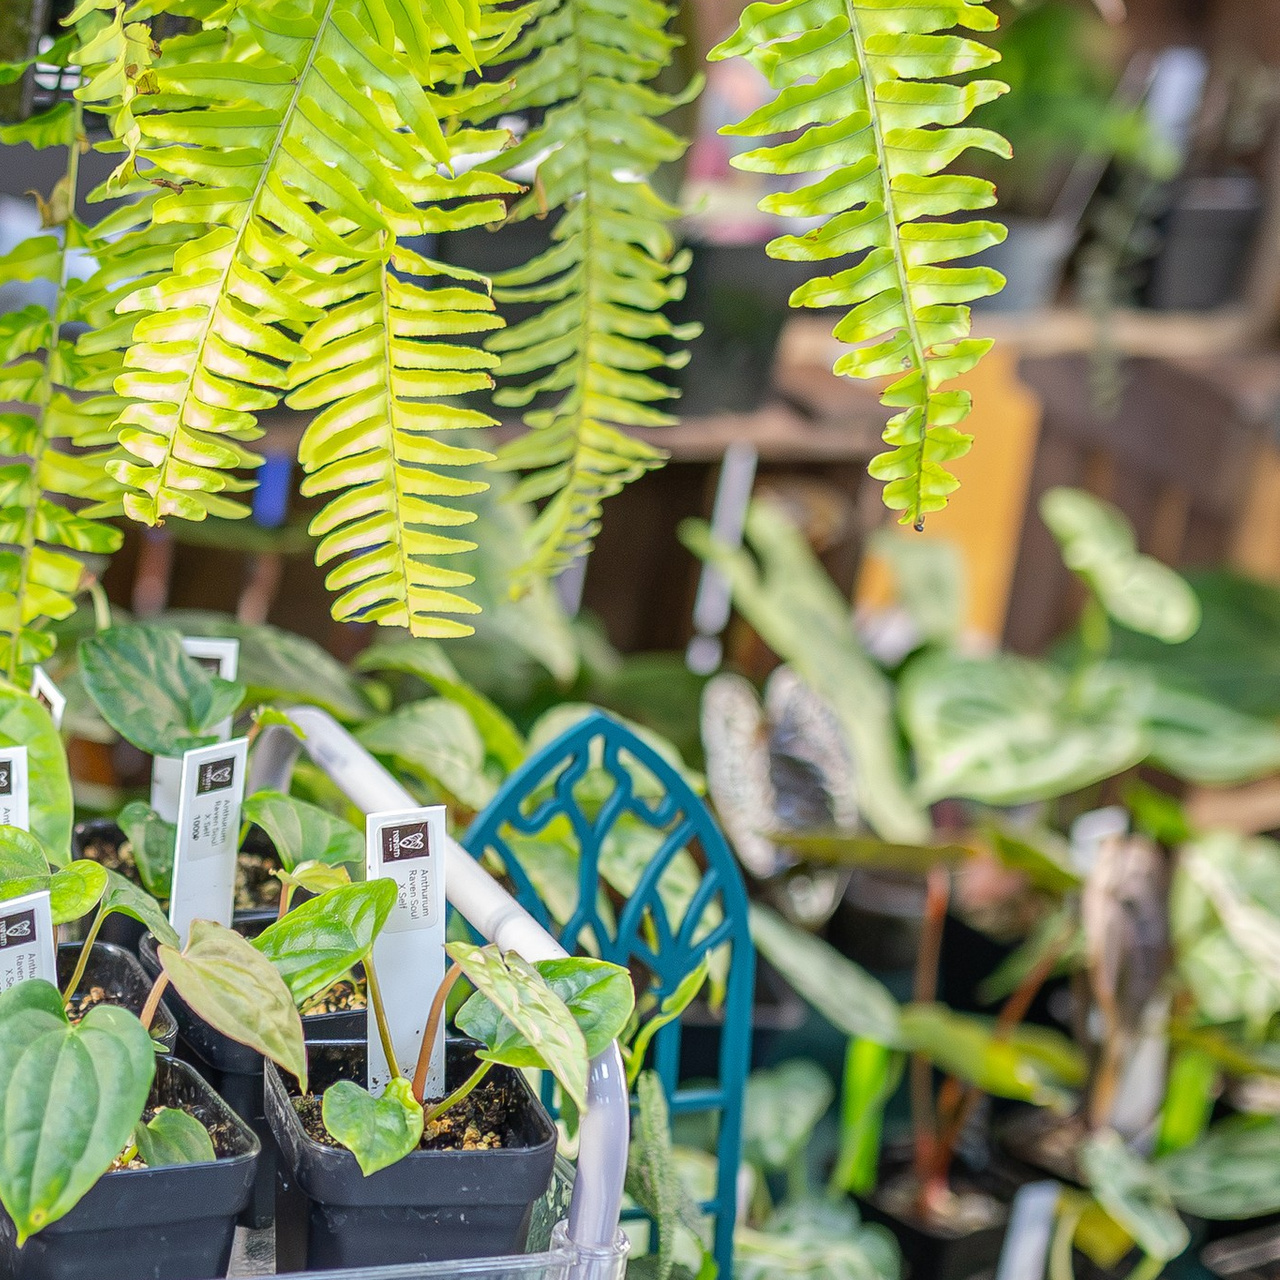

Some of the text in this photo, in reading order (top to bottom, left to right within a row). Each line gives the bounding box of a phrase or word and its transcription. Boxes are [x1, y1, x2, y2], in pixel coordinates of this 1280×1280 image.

[212, 801, 221, 826] Raven
[220, 800, 231, 843] Anthurium
[192, 816, 202, 841] 1000₽
[399, 892, 408, 909] Self
[409, 870, 420, 919] Raven Soul
[420, 869, 430, 916] Anthurium
[16, 955, 25, 981] Raven
